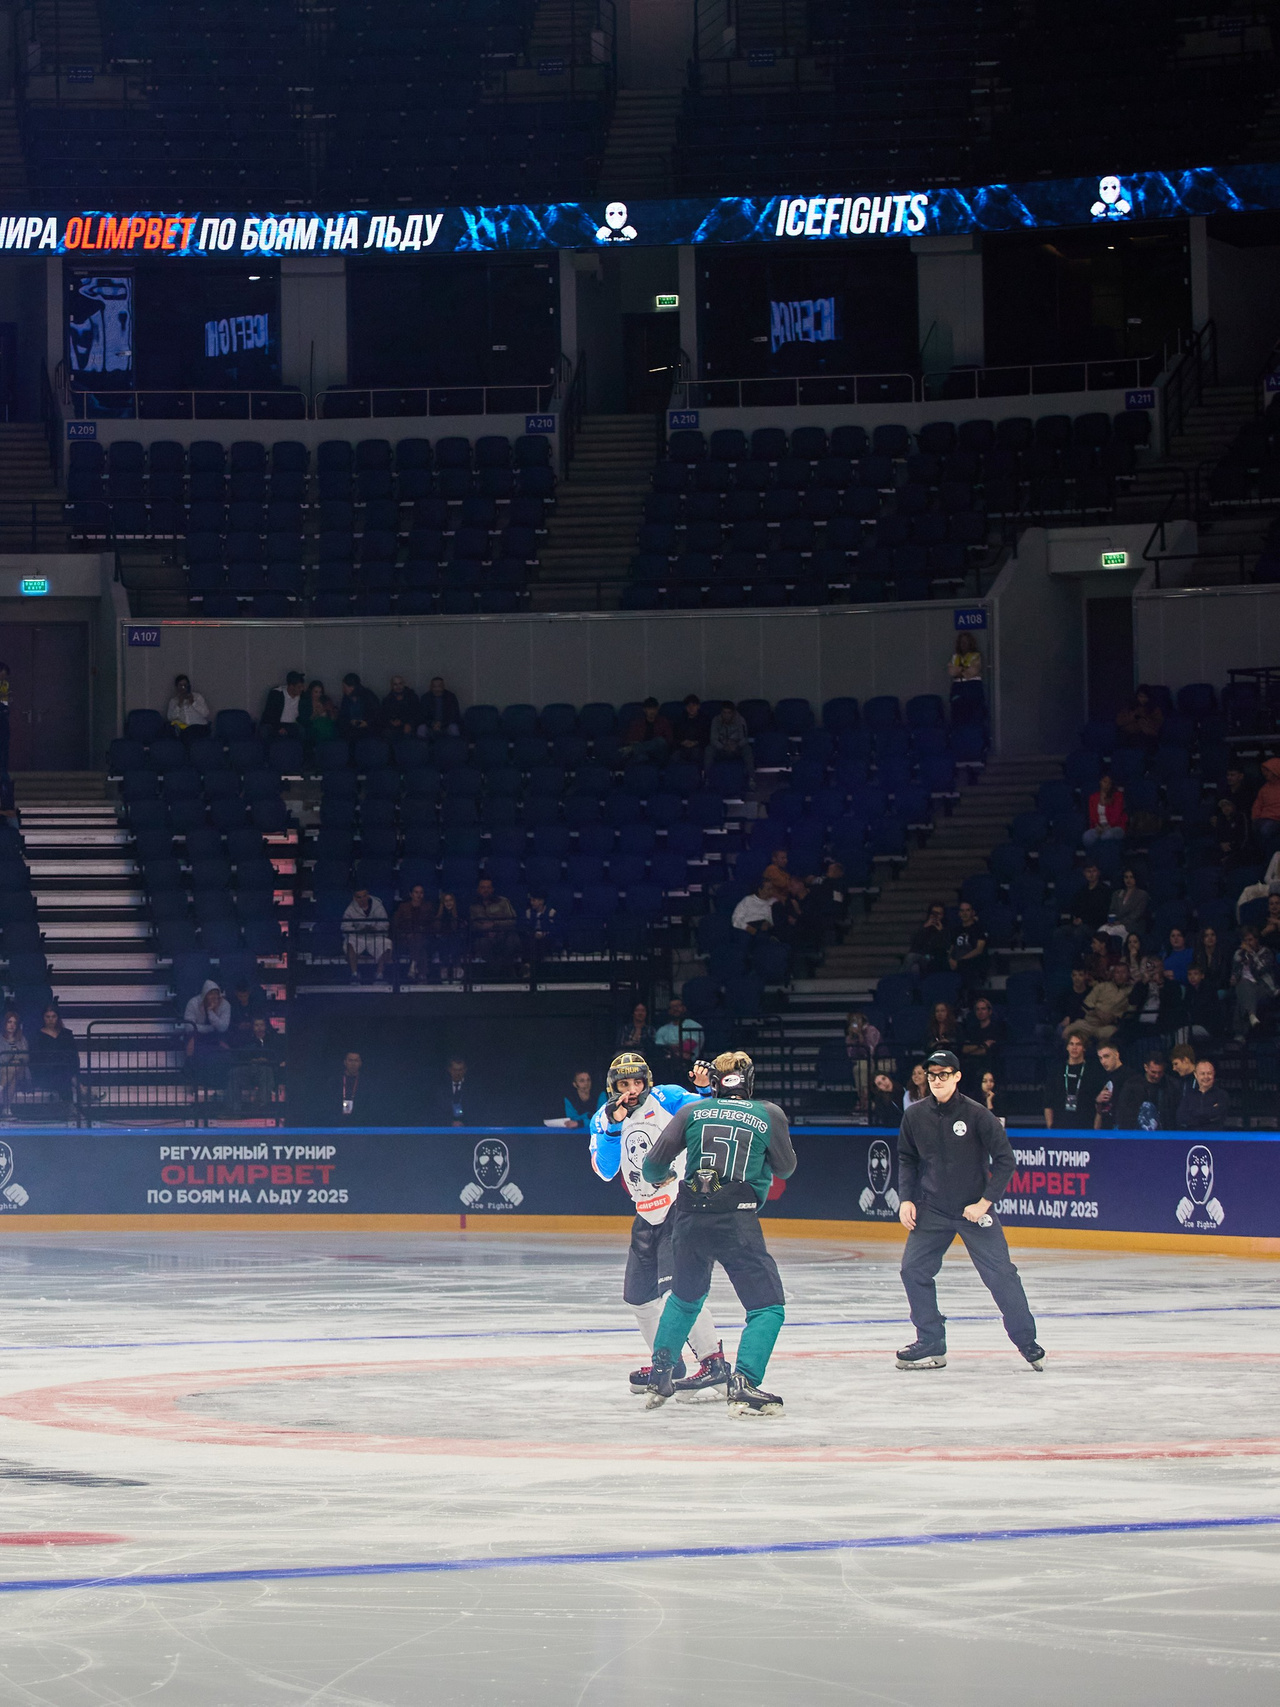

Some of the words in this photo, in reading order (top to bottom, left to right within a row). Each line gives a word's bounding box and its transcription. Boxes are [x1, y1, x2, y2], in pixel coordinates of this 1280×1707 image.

[775, 194, 929, 236] ICEFIGHTS
[64, 216, 196, 249] OLIMPBET
[198, 217, 237, 250] ПО
[240, 217, 320, 250] БОЯМ
[322, 217, 358, 250] НА
[363, 213, 444, 251] ЛЬДУ
[693, 1108, 719, 1121] ICE
[719, 1109, 769, 1134] FIGHTS
[160, 1143, 269, 1160] РЕГУЛЯРНЫЙ
[273, 1145, 336, 1160] ТУРНИР
[699, 1124, 754, 1182] 51
[1048, 1150, 1090, 1167] ТУРНИР
[161, 1165, 335, 1185] OLIMPBET
[147, 1190, 172, 1204] ПО
[176, 1190, 224, 1204] БОЯМ
[228, 1190, 252, 1204] НА
[256, 1190, 302, 1205] ЛЬДУ
[307, 1190, 349, 1204] 2025
[994, 1199, 1018, 1214] ОЯМ
[1020, 1199, 1035, 1216] НА
[1038, 1200, 1068, 1219] ЛЬДУ
[1070, 1202, 1099, 1218] 2025
